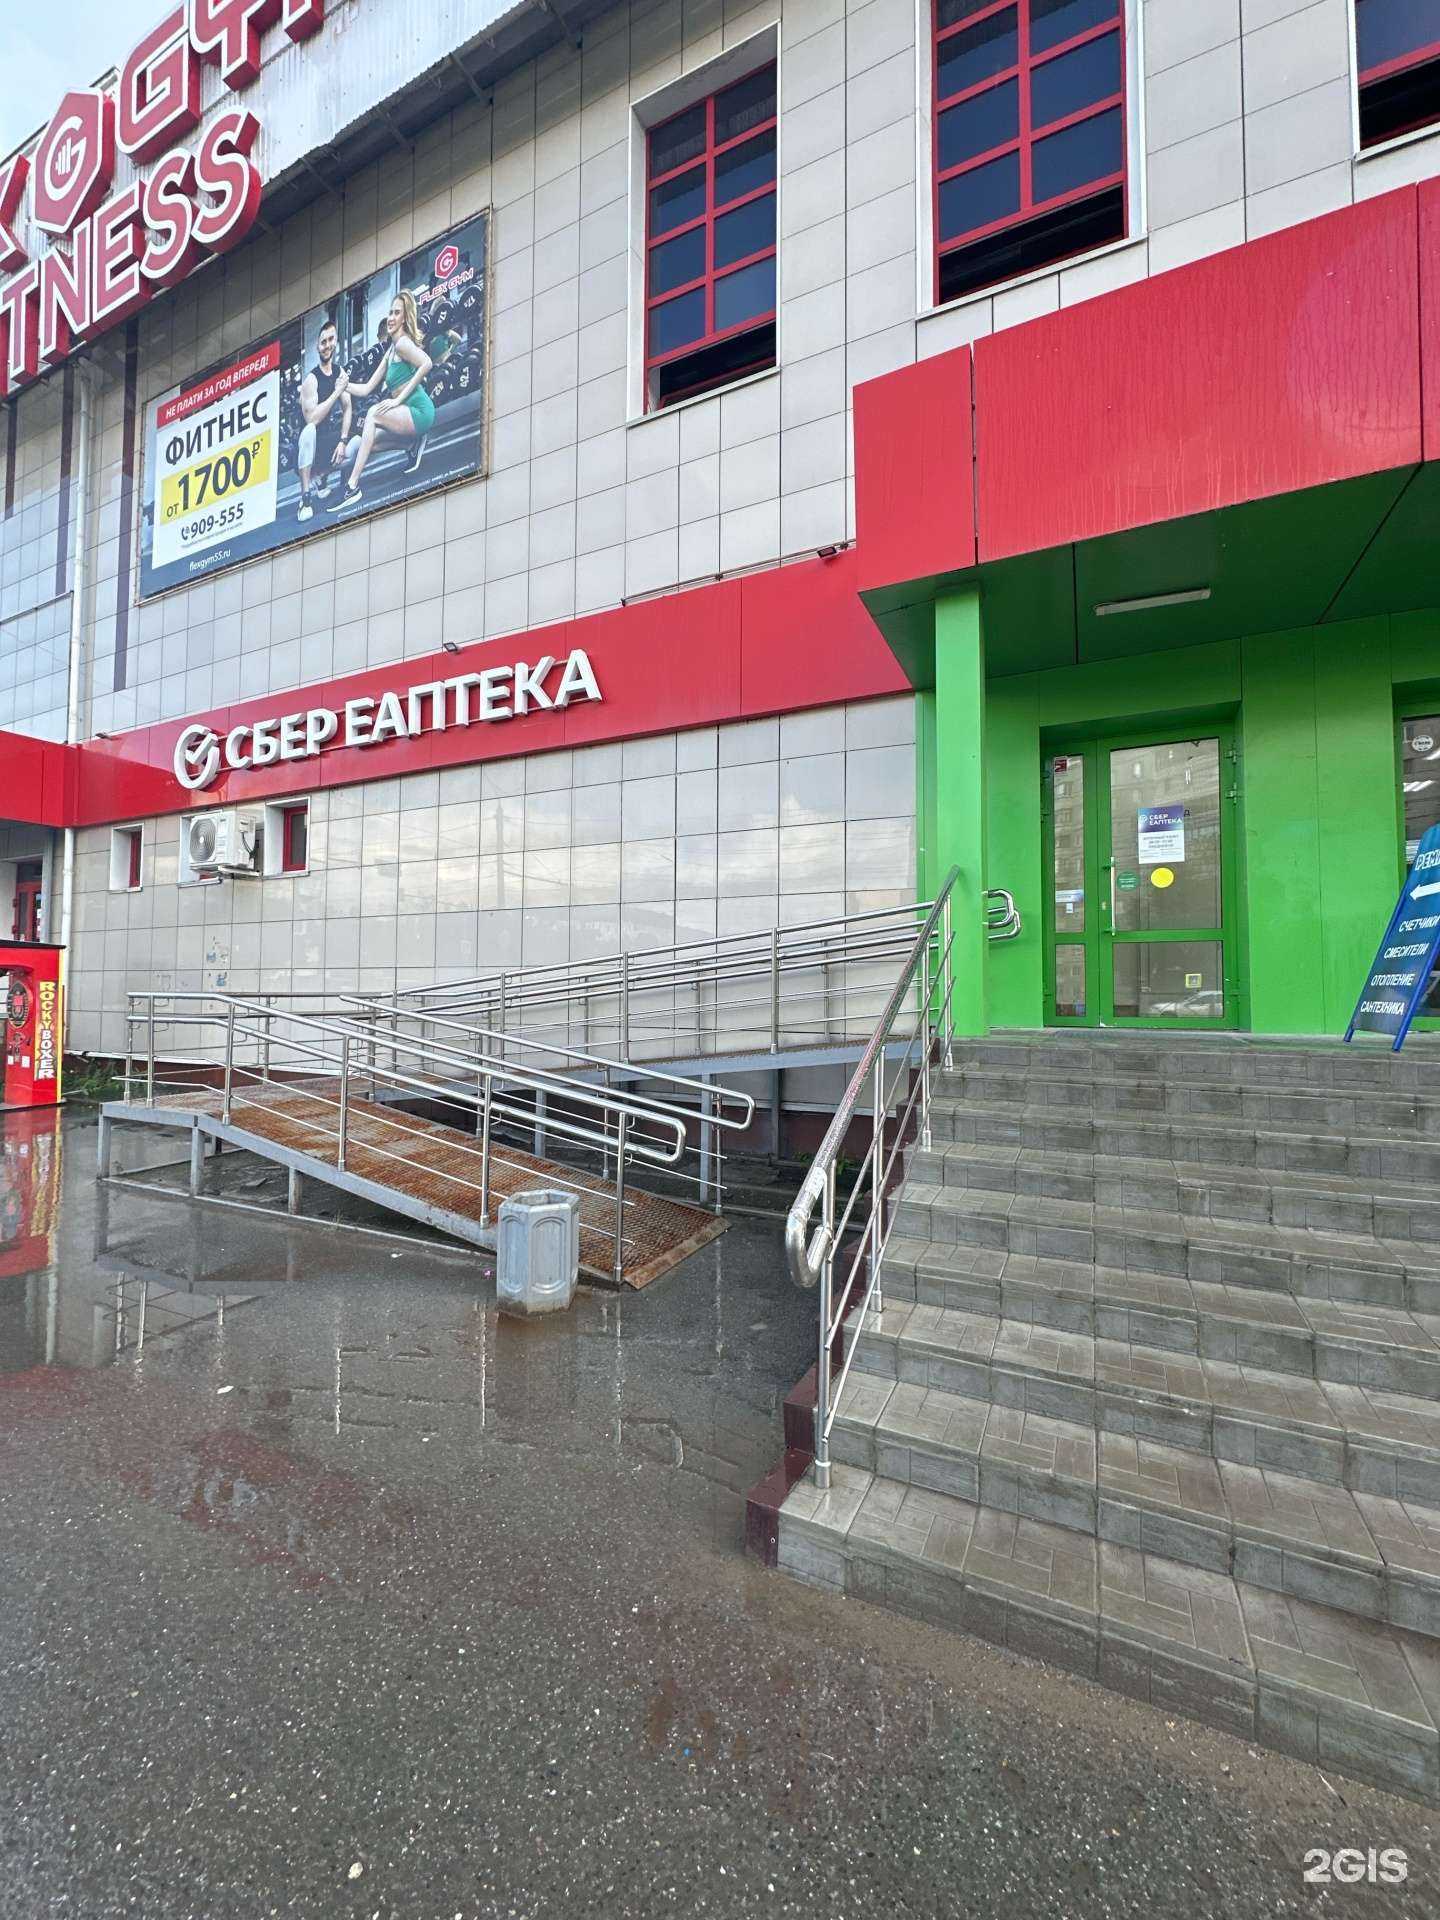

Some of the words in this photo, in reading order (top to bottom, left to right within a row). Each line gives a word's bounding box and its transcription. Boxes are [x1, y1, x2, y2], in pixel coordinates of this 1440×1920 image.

[419, 281, 448, 306] FLEX
[165, 405, 177, 420] НЕ
[176, 390, 203, 412] ПЛАТИ
[204, 385, 214, 400] ЗА
[215, 374, 232, 393] ГОД
[232, 354, 269, 383] ВПЕРЕД!
[165, 391, 268, 466] ФИТНЕС
[190, 502, 244, 539] 909-555
[225, 707, 338, 770] СБЕР
[344, 648, 603, 746] ЕАПТЕКА
[1384, 943, 1429, 958] СМЕСИТЕЛИ
[1371, 973, 1415, 986] ОТОПЛЕНИЕ
[39, 981, 56, 1029] ROCKY
[1361, 1001, 1405, 1015] САНТЕХНИКА
[38, 1029, 56, 1080] BOXER
